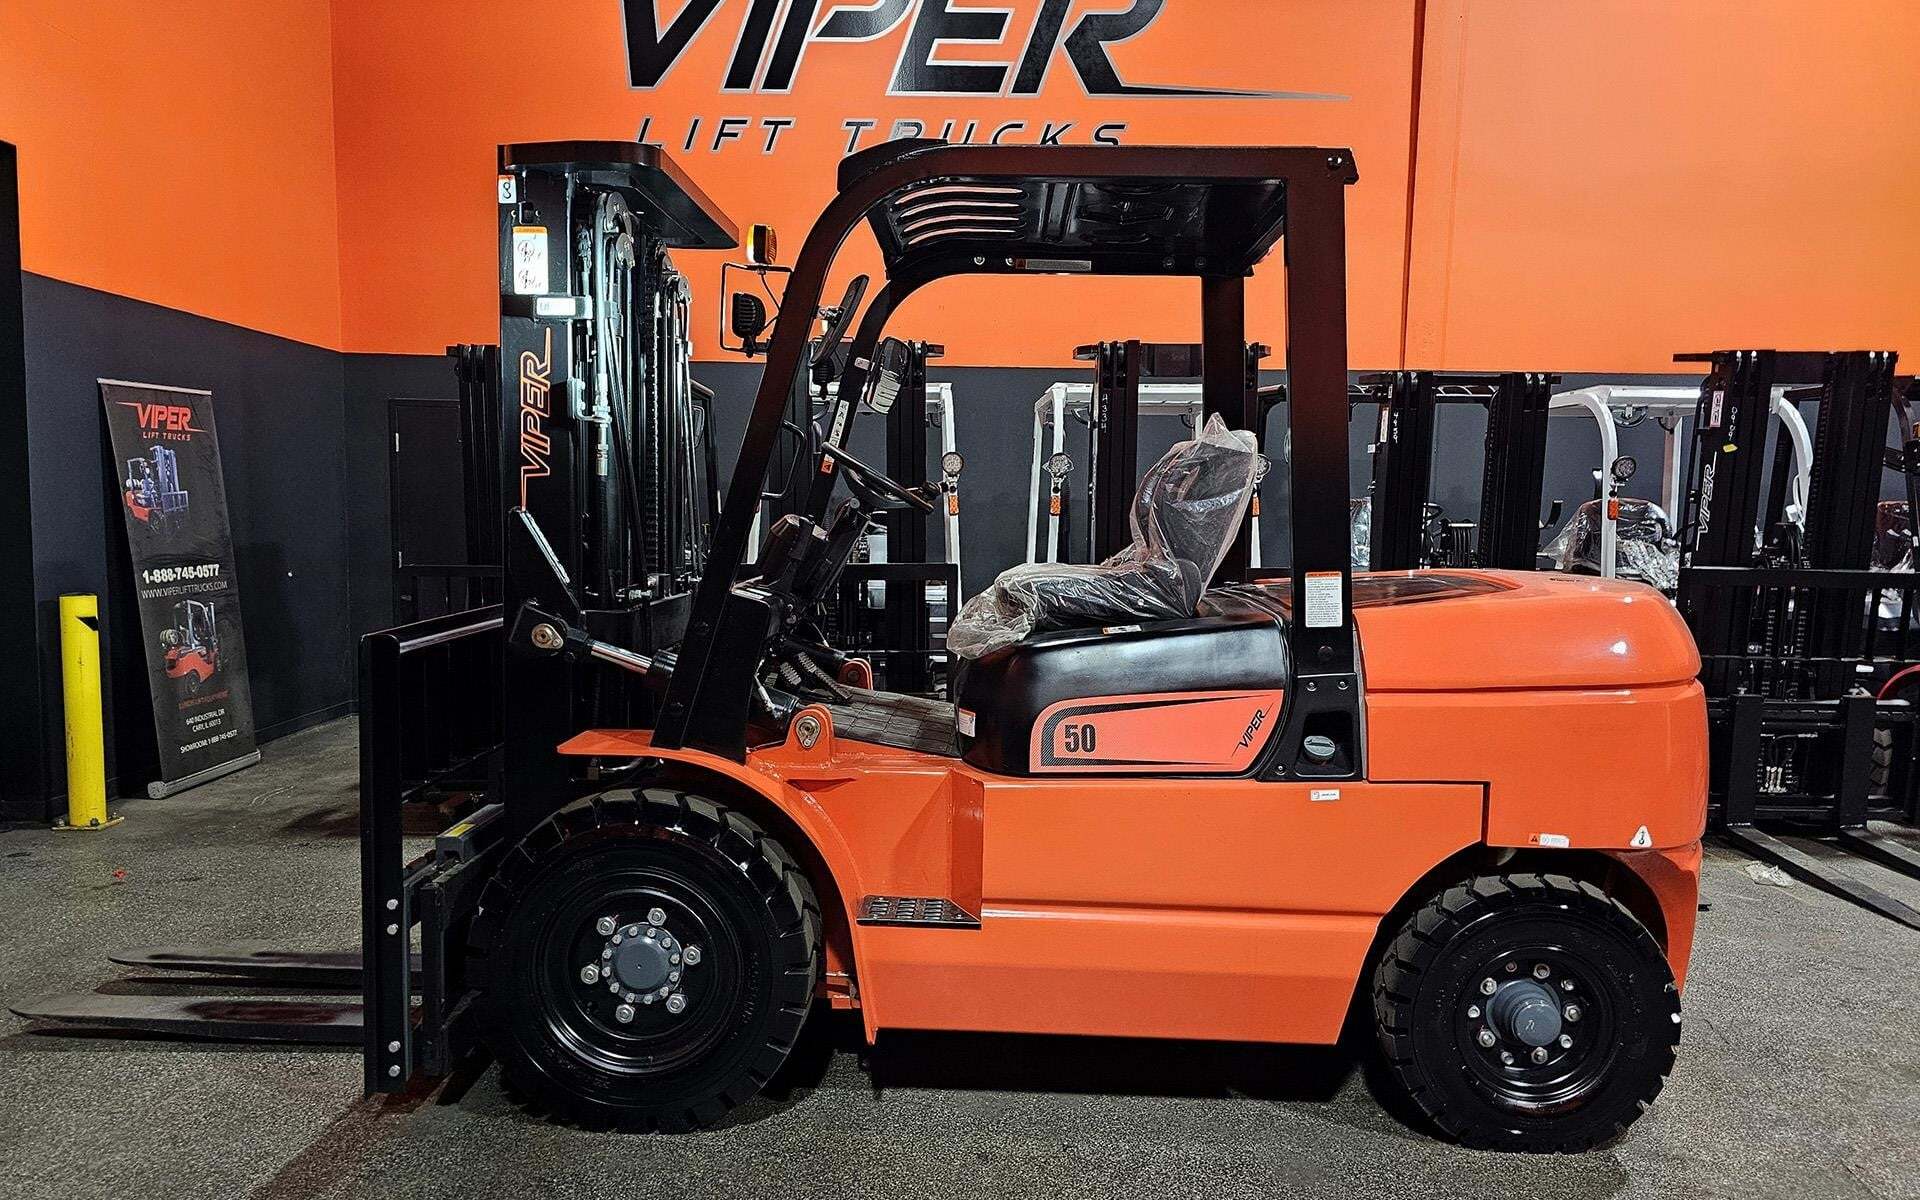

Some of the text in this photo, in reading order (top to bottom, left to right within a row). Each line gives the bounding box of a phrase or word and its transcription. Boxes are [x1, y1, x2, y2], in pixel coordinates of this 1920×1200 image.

[624, 0, 1350, 98] VIPER
[634, 116, 796, 155] LIFT
[118, 402, 203, 431] VIPER
[520, 327, 551, 511] VIPER
[143, 431, 191, 441] LIFT TRUCKS
[1696, 452, 1717, 550] VIPER
[141, 581, 228, 599] WWW.VIPERLIFTTRUCKS.COM
[142, 564, 219, 584] 1-888-745-0577
[1064, 724, 1096, 753] 50
[1235, 705, 1270, 752] VIPER
